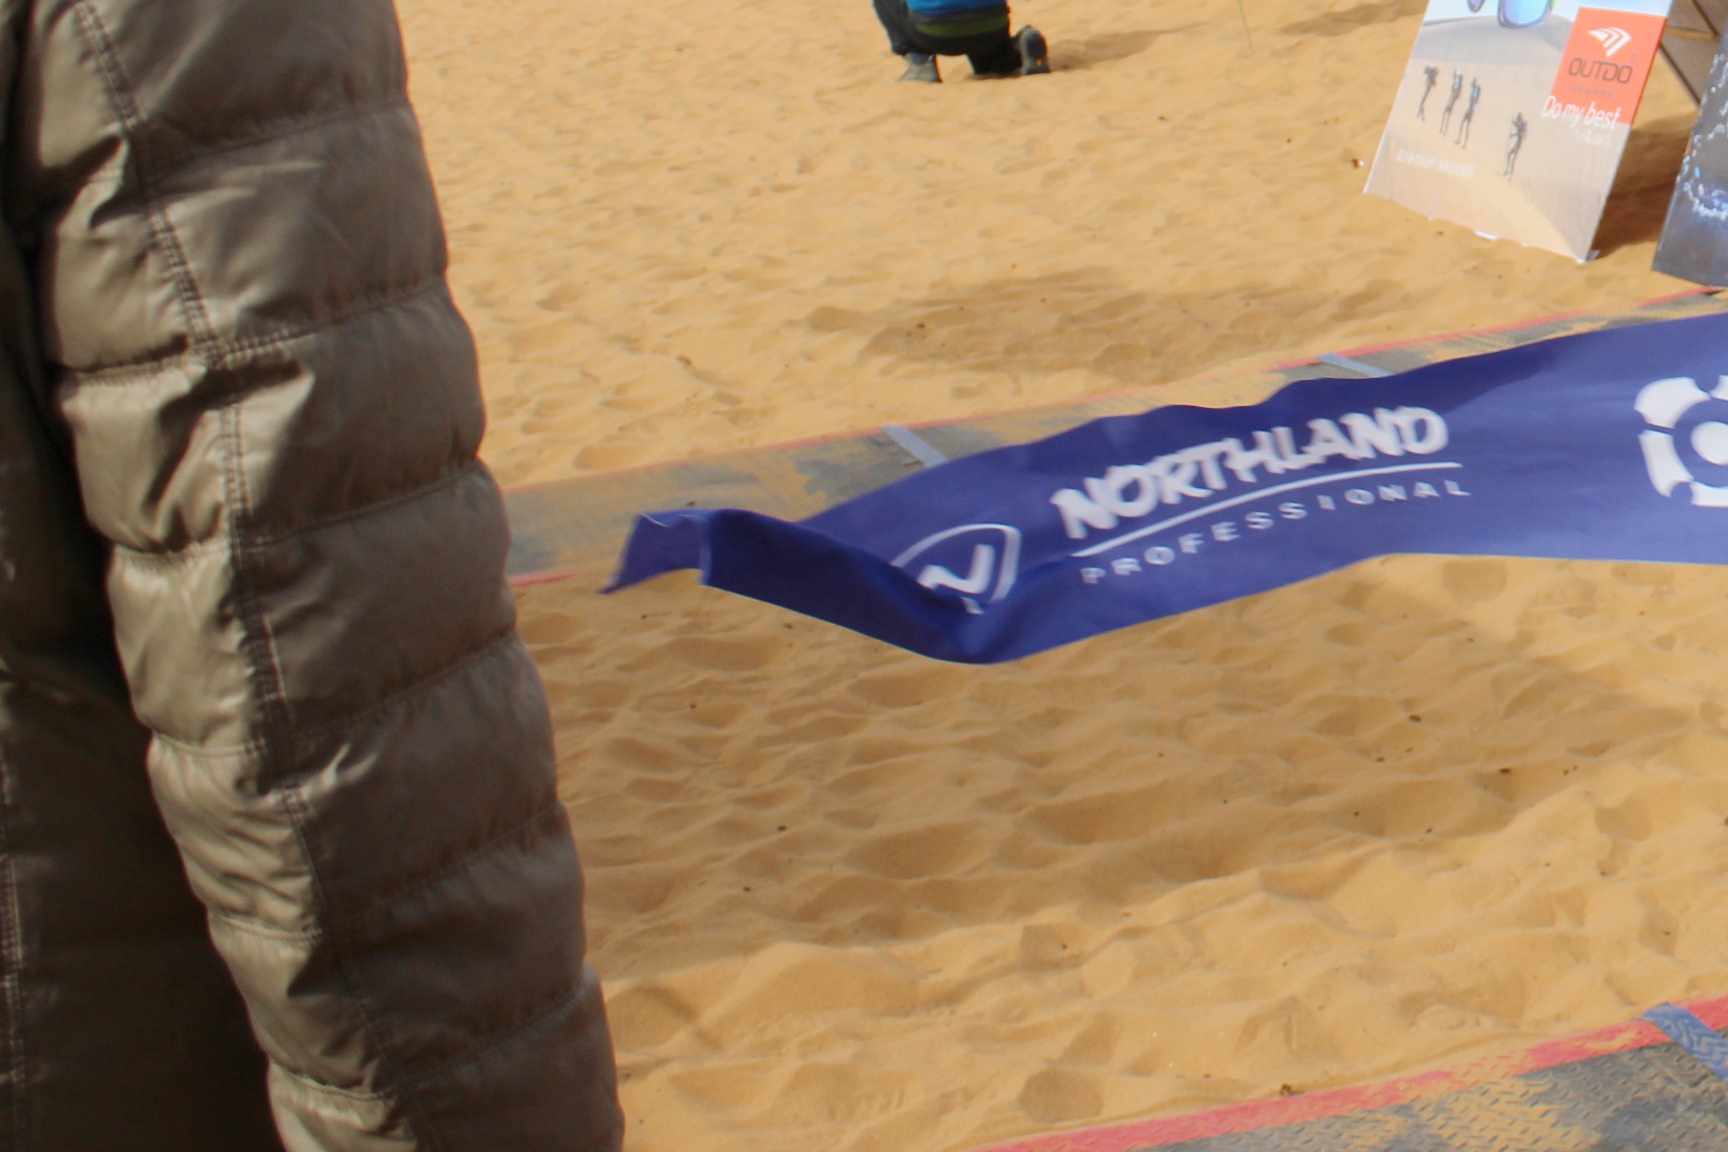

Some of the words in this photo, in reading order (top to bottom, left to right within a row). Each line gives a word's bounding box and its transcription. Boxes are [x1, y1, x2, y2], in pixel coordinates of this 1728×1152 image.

[1568, 57, 1633, 85] OUTDO
[1541, 95, 1562, 119] Do
[1562, 102, 1586, 128] my
[1584, 100, 1622, 130] best
[1048, 405, 1450, 541] NORTHLAND
[1080, 478, 1472, 585] PROFESSIONAL
